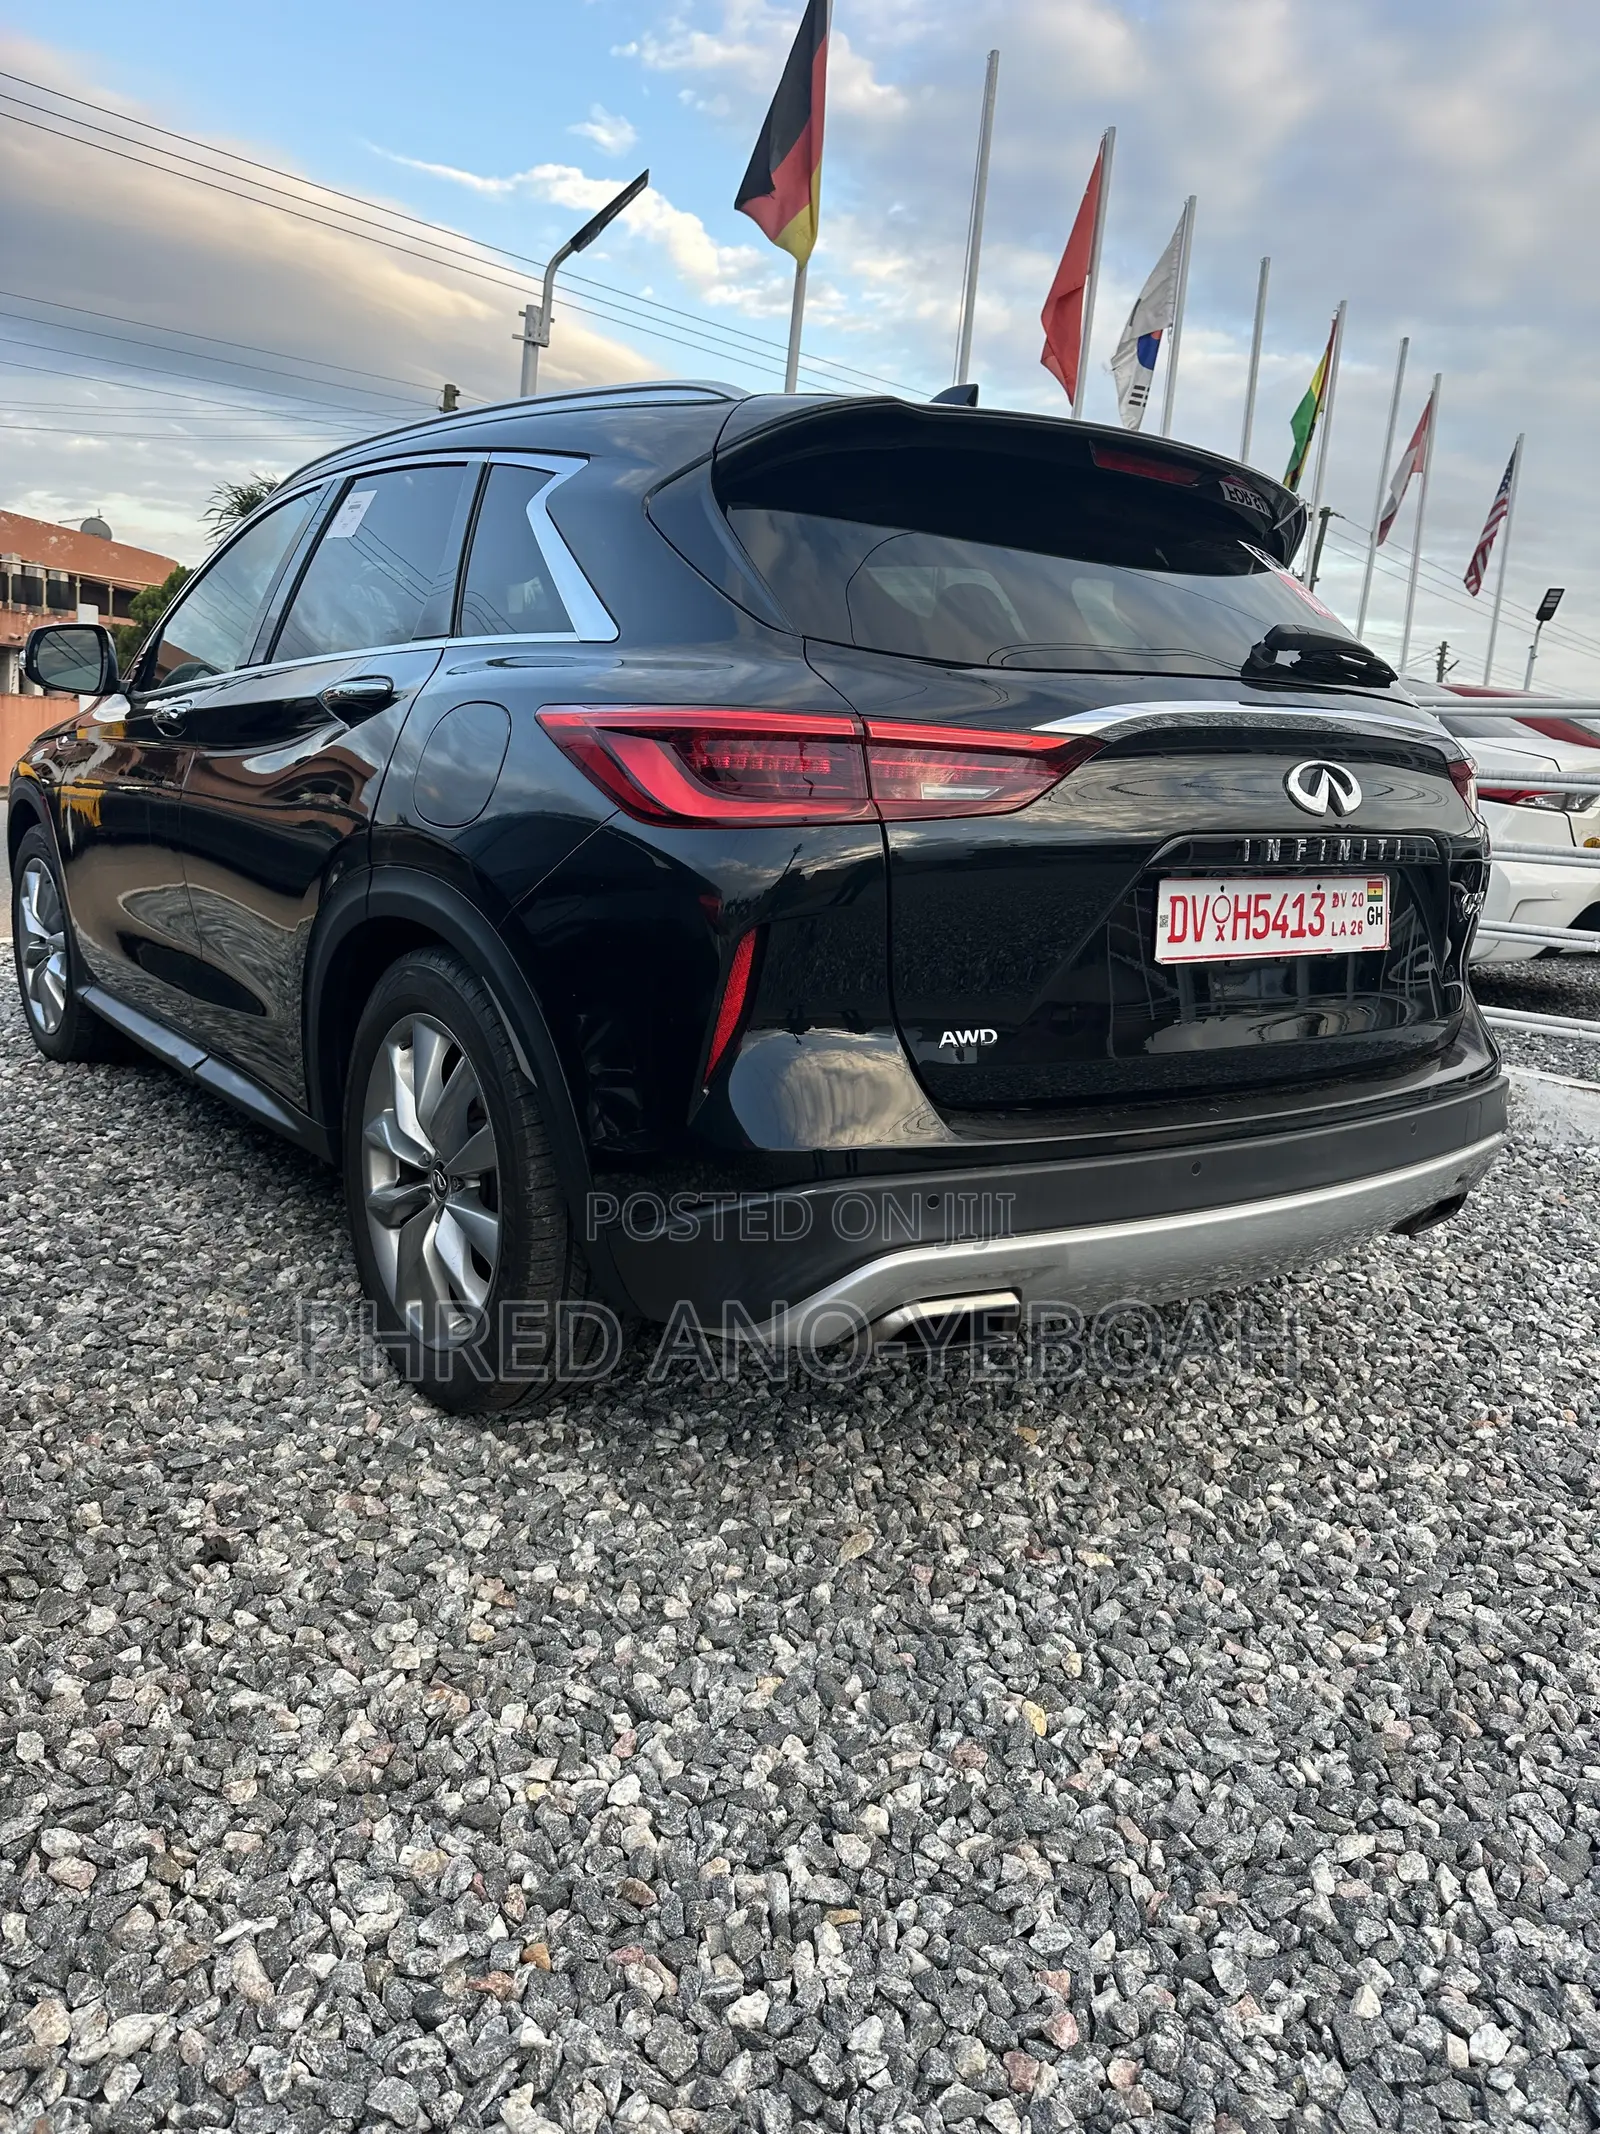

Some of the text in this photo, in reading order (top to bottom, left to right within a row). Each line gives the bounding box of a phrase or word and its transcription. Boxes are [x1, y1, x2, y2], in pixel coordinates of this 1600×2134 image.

[1244, 838, 1402, 862] INFINITI
[1351, 891, 1365, 908] 20
[1366, 906, 1383, 926] GH
[1331, 919, 1364, 937] LA 26
[938, 1028, 998, 1049] AWD
